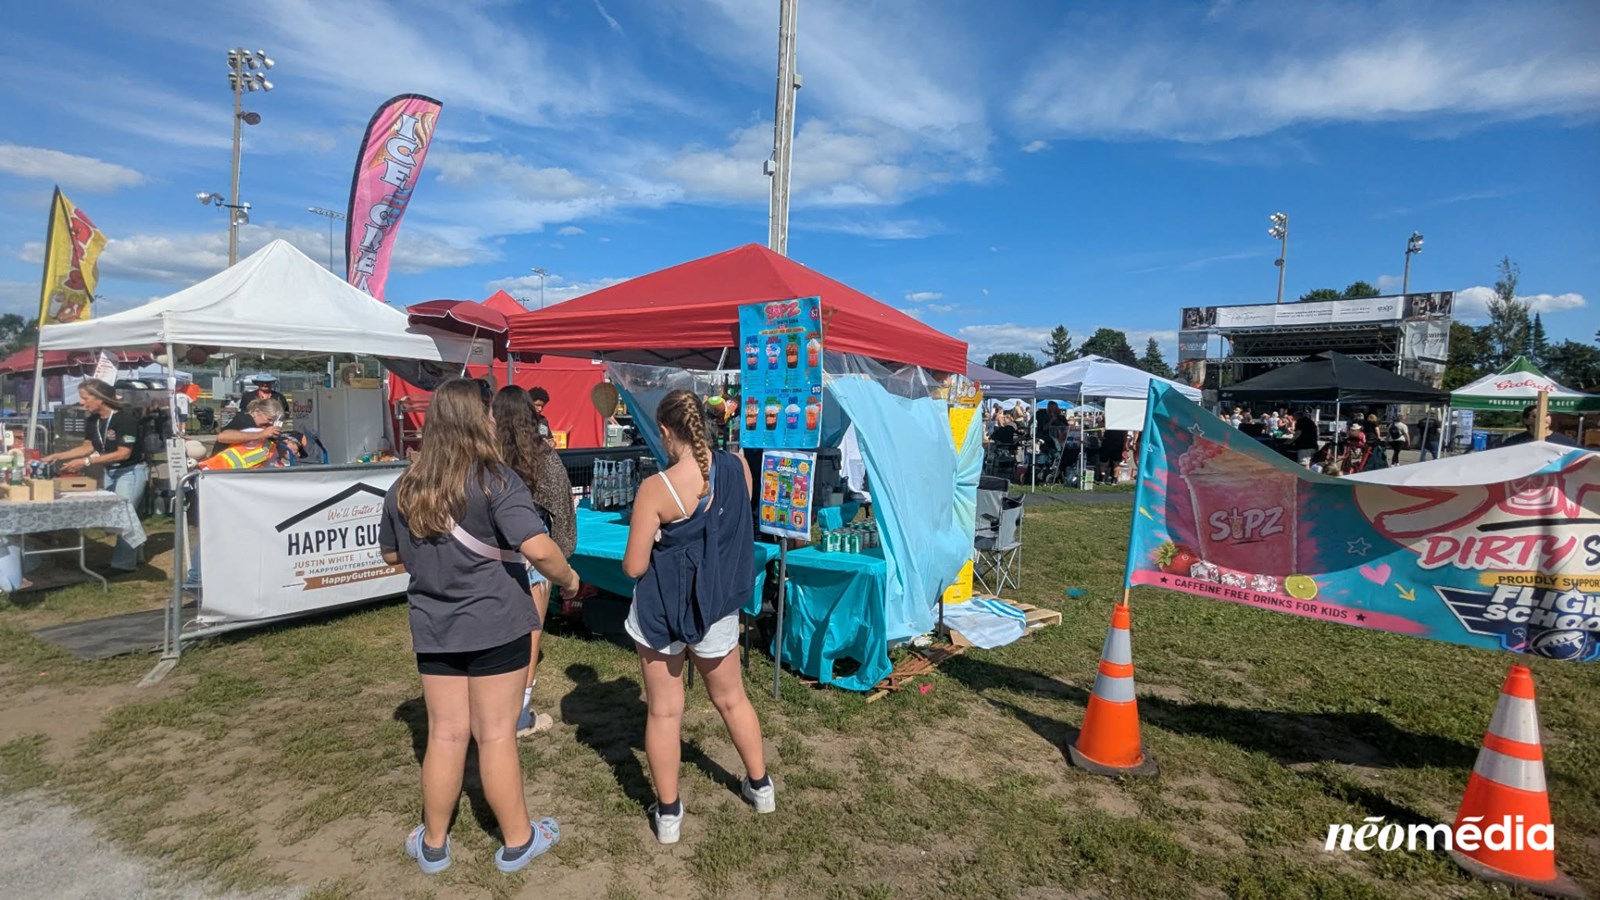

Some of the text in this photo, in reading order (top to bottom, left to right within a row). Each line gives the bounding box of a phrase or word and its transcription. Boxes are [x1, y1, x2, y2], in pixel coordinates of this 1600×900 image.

[380, 112, 419, 189] ICE
[327, 507, 350, 520] We'll
[351, 505, 374, 516] Gutter
[288, 527, 349, 556] HAPPY
[1422, 534, 1577, 571] DIRTY
[292, 558, 325, 569] JUSTIN
[328, 554, 355, 564] WHITE
[321, 567, 395, 584] HappyGutters.ca
[1498, 575, 1558, 586] PROUDLY
[1174, 578, 1348, 620] CAFFEINE FREE DRINKS FOR KIDS
[1490, 584, 1600, 616] FLIGH
[1482, 604, 1600, 631] SCHOO
